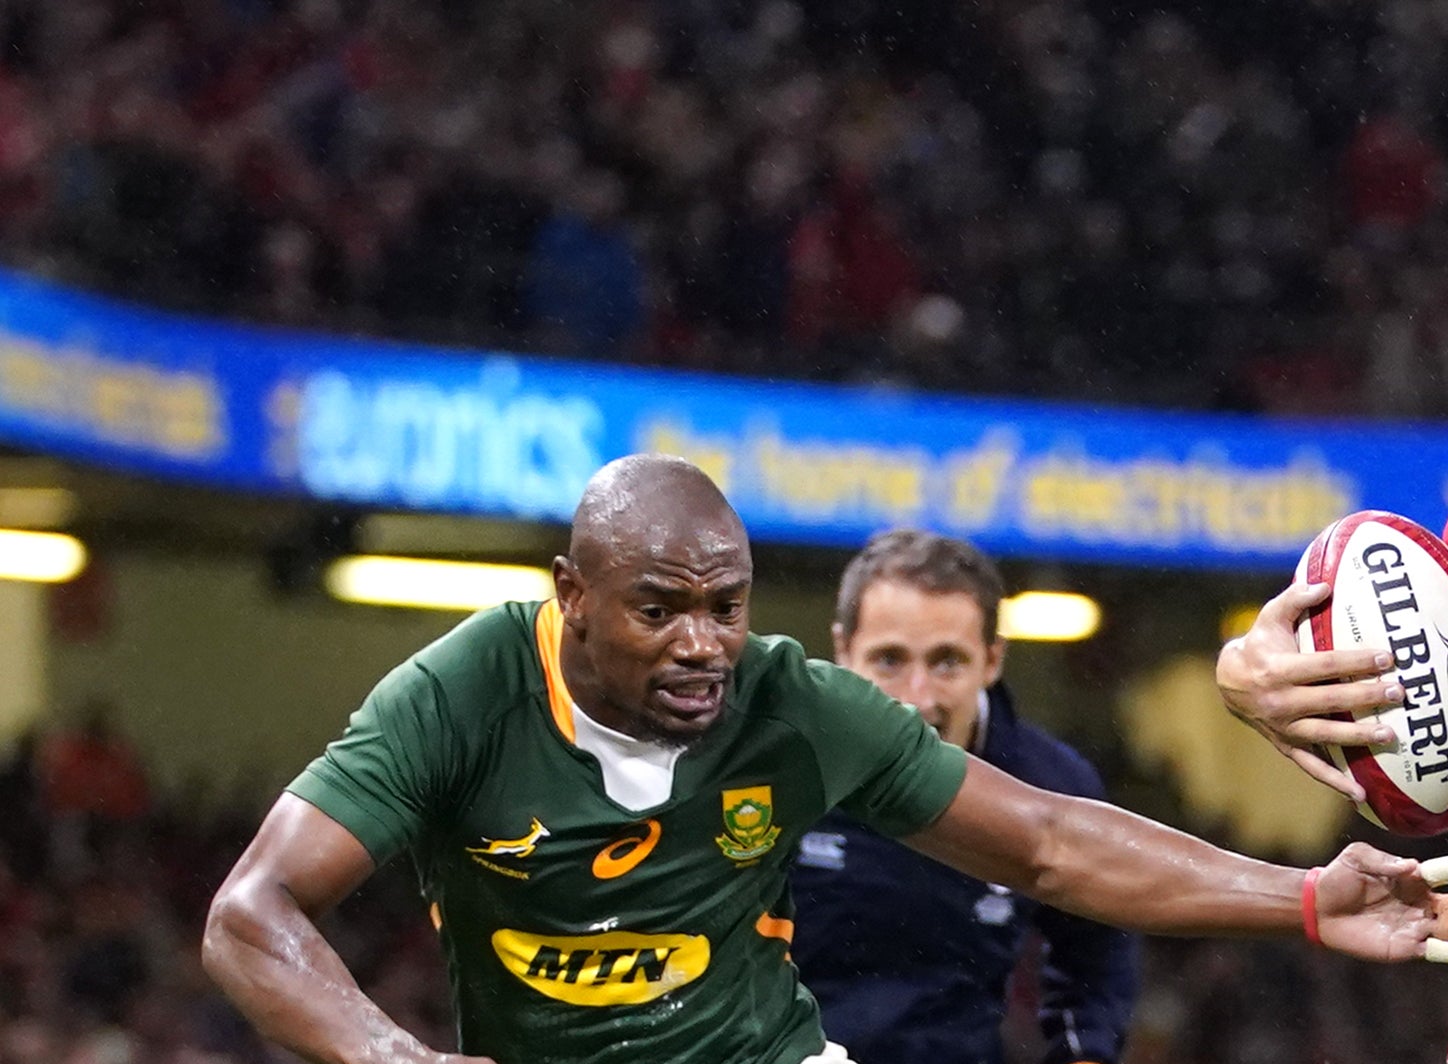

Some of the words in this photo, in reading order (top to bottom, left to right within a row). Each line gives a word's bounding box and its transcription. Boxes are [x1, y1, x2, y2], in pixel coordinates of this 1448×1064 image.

[300, 355, 604, 516] euronics
[752, 425, 925, 526] home
[943, 424, 1017, 528] of
[526, 945, 682, 984] MTN
